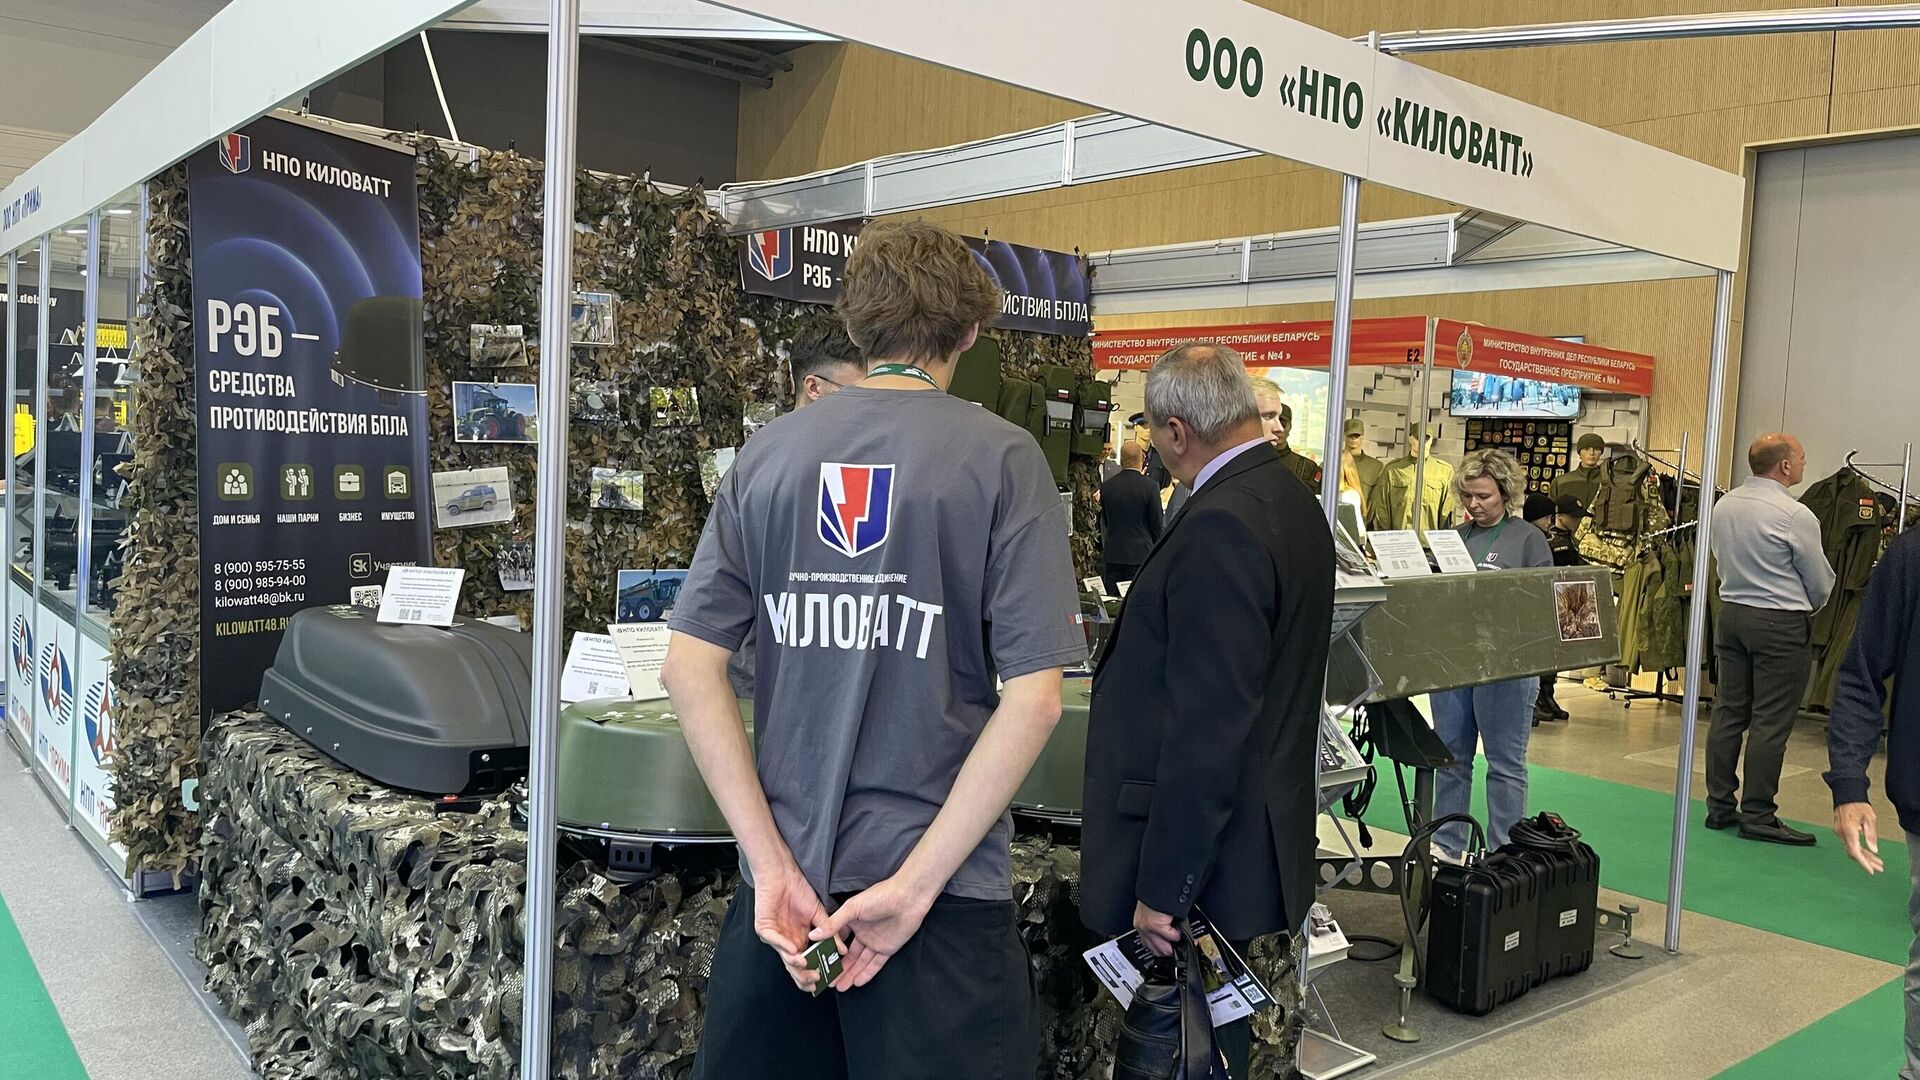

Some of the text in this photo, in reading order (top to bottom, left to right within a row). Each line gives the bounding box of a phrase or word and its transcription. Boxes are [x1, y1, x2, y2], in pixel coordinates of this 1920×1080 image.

[1186, 28, 1364, 130] ООО «НПО
[1376, 97, 1534, 178] «КИЛОВАТТ»
[262, 150, 392, 198] НПО КИЛОВАТТ
[803, 226, 839, 257] НПО
[803, 263, 832, 289] РЭБ
[999, 290, 1089, 323] ЙСТВИЯ БПЛА
[207, 299, 282, 358] РЭБ
[1215, 333, 1271, 345] РЕСПУБЛИКИ
[1272, 331, 1320, 342] БЕЛАРУСЬ
[1267, 350, 1284, 361] №4
[1406, 348, 1421, 363] E2
[1483, 338, 1636, 371] МИНИСТЕРСТВО ВНУТРЕННИХ ДЕЛ РЕСПУБЛИКИ БЕЛАРУСЬ
[209, 369, 296, 397] СРЕДСТВА
[1499, 358, 1560, 377] ГОСУДАРСТВЕННОЕ
[1560, 368, 1602, 383] ПРЕДПРИЯТИЕ
[209, 404, 409, 437] ПРОТИВОДЕЙСТВИЯ БПЛА
[212, 514, 261, 526] ДОМ И СЕМЬЯ
[277, 512, 320, 523] НАШИ ПАРНИ
[338, 511, 363, 522] БИЗНЕС
[381, 511, 415, 521] ИМУЩЕСТВО
[214, 558, 306, 577] 8 (900) 595-75-55
[352, 559, 368, 573] Sk
[214, 575, 306, 593] 8 (900) 985-94-00
[215, 591, 305, 608] kilowatt48@bk.ru
[80, 779, 96, 818] НПП
